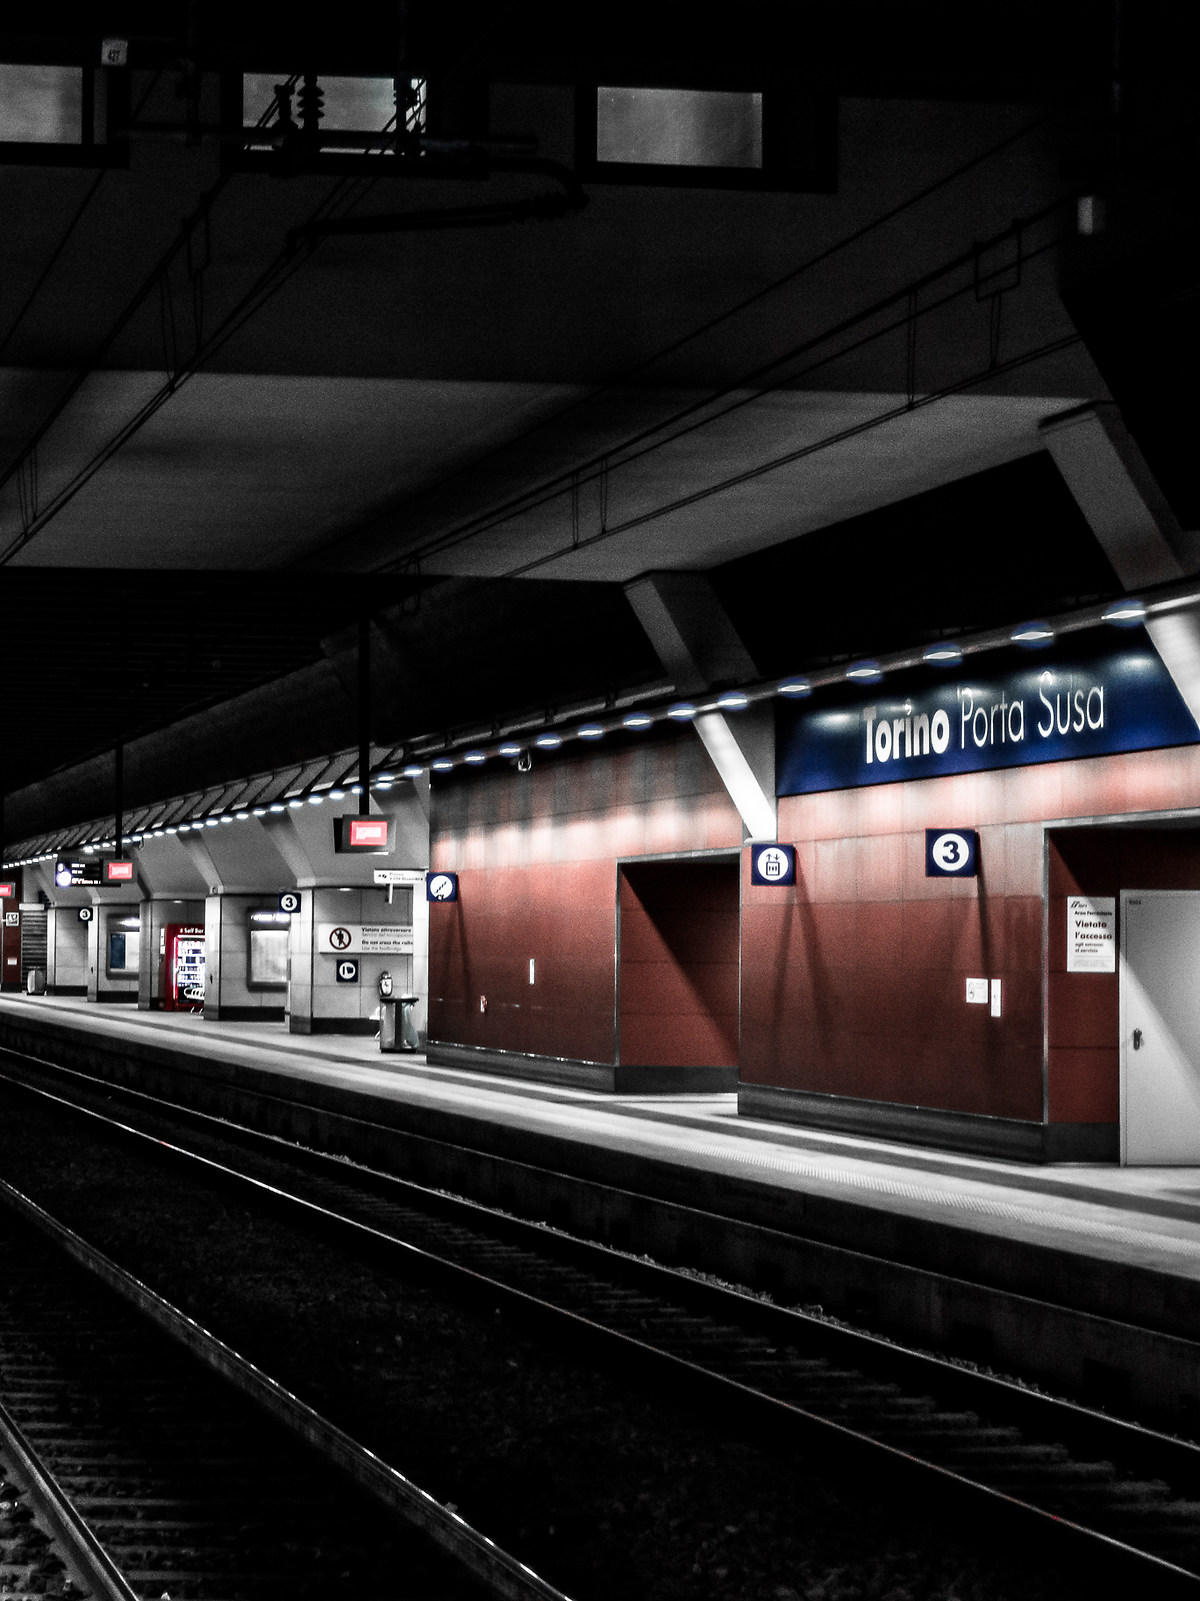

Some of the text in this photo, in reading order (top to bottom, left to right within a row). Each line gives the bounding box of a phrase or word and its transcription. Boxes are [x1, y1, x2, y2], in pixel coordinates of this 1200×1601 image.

[863, 671, 1105, 764] Torino Porta Susa
[941, 840, 960, 864] 3
[285, 896, 294, 908] 3
[82, 910, 88, 918] 3
[1075, 920, 1107, 928] Vietato
[1075, 931, 1113, 940] l'accesso
